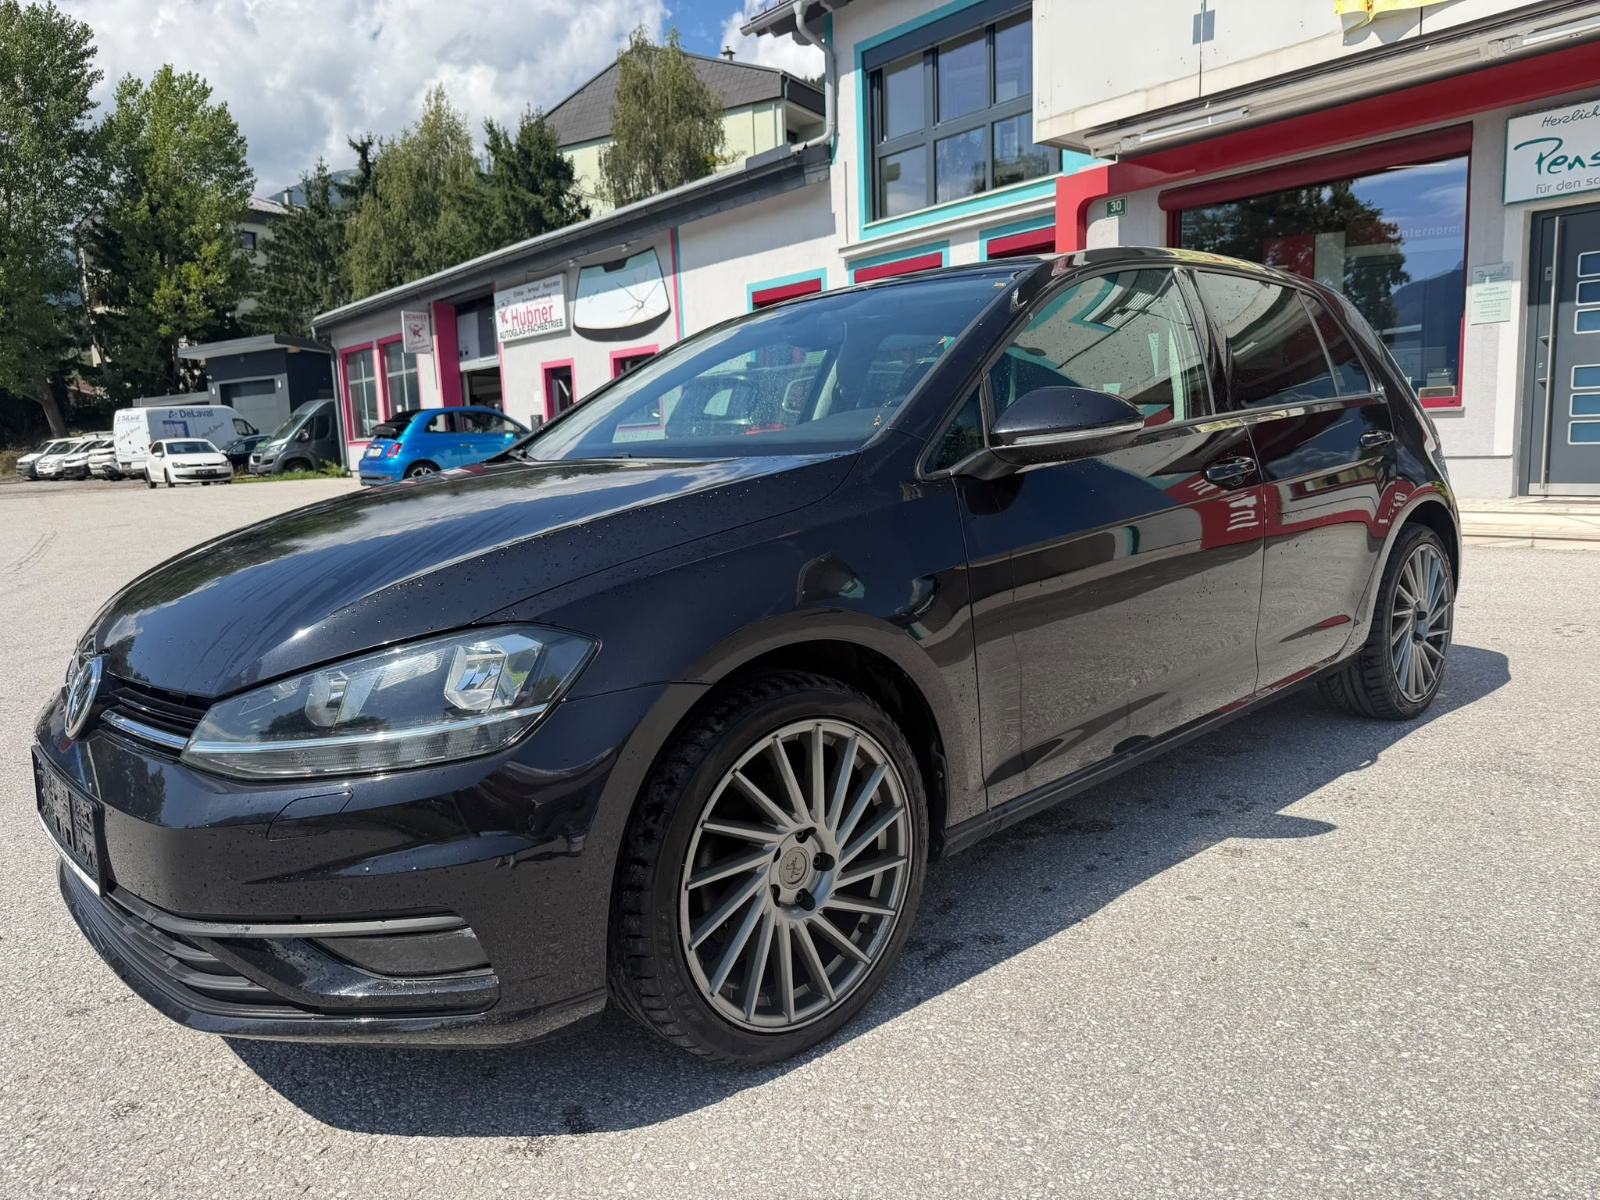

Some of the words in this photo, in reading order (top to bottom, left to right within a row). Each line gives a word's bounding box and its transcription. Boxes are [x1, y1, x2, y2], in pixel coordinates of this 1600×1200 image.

[1536, 184, 1552, 194] für
[1556, 180, 1581, 191] den
[1110, 200, 1121, 212] 30
[1397, 224, 1461, 238] nternorm
[179, 409, 215, 419] DeLaval
